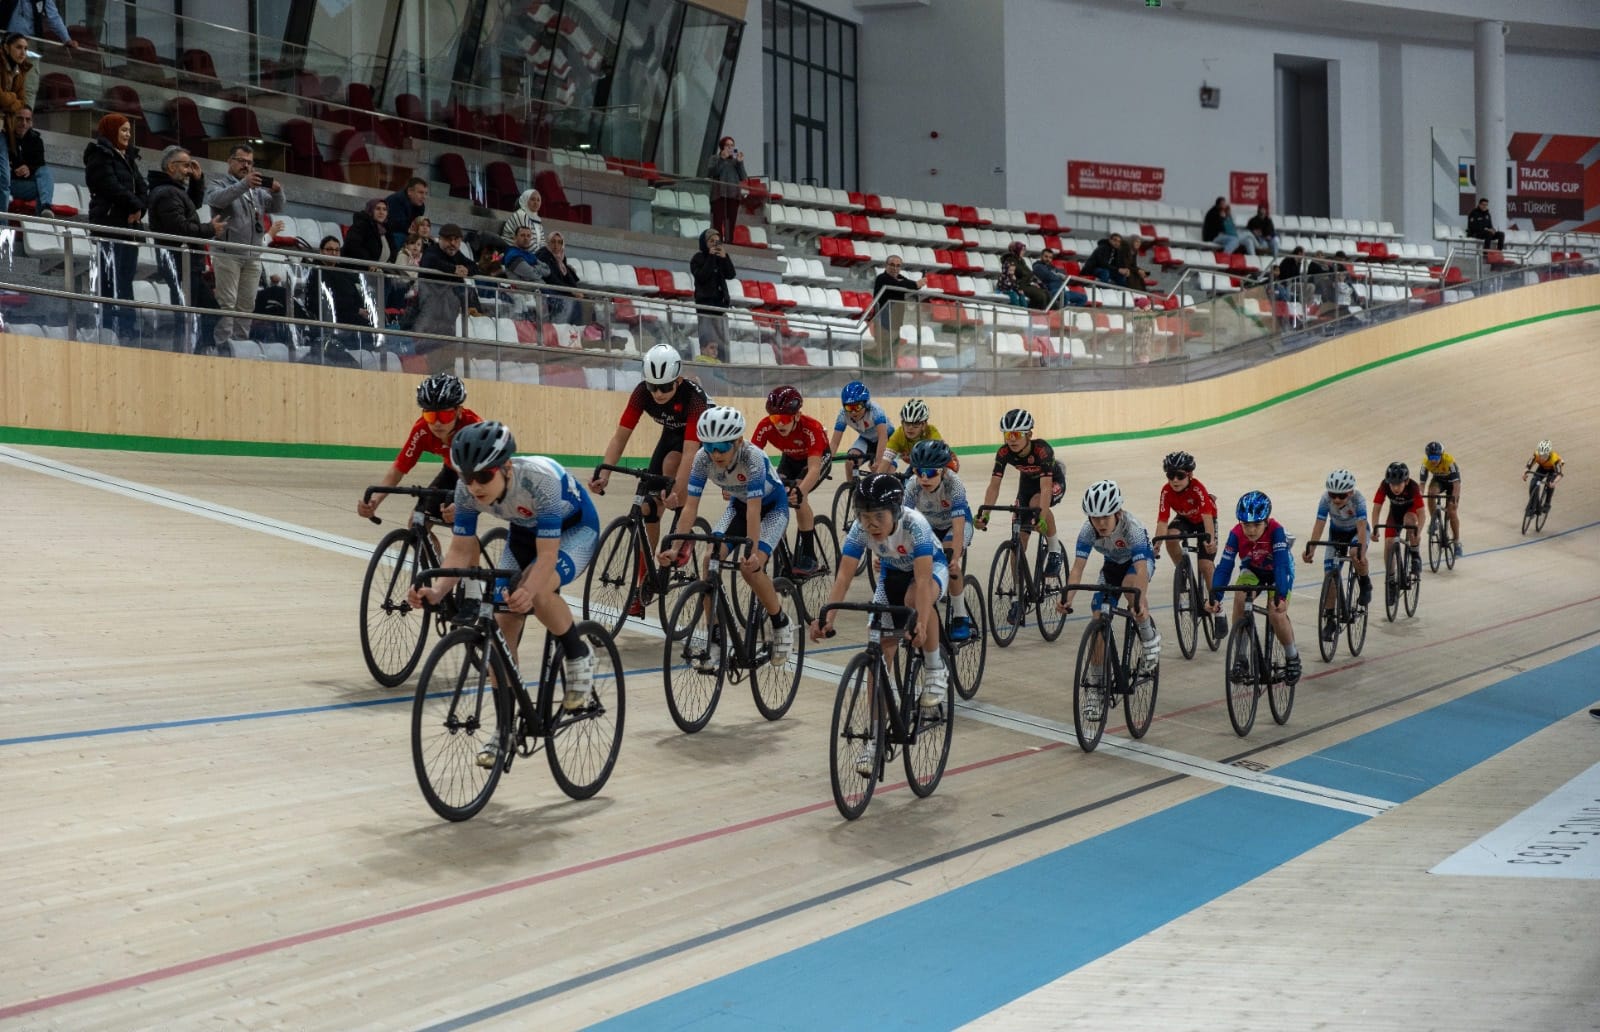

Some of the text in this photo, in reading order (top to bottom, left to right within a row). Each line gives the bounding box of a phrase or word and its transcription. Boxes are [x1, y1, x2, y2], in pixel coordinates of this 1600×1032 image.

[1521, 167, 1549, 178] TRACK
[1520, 181, 1580, 193] NATIONS CUP
[1506, 839, 1588, 865] 1853
